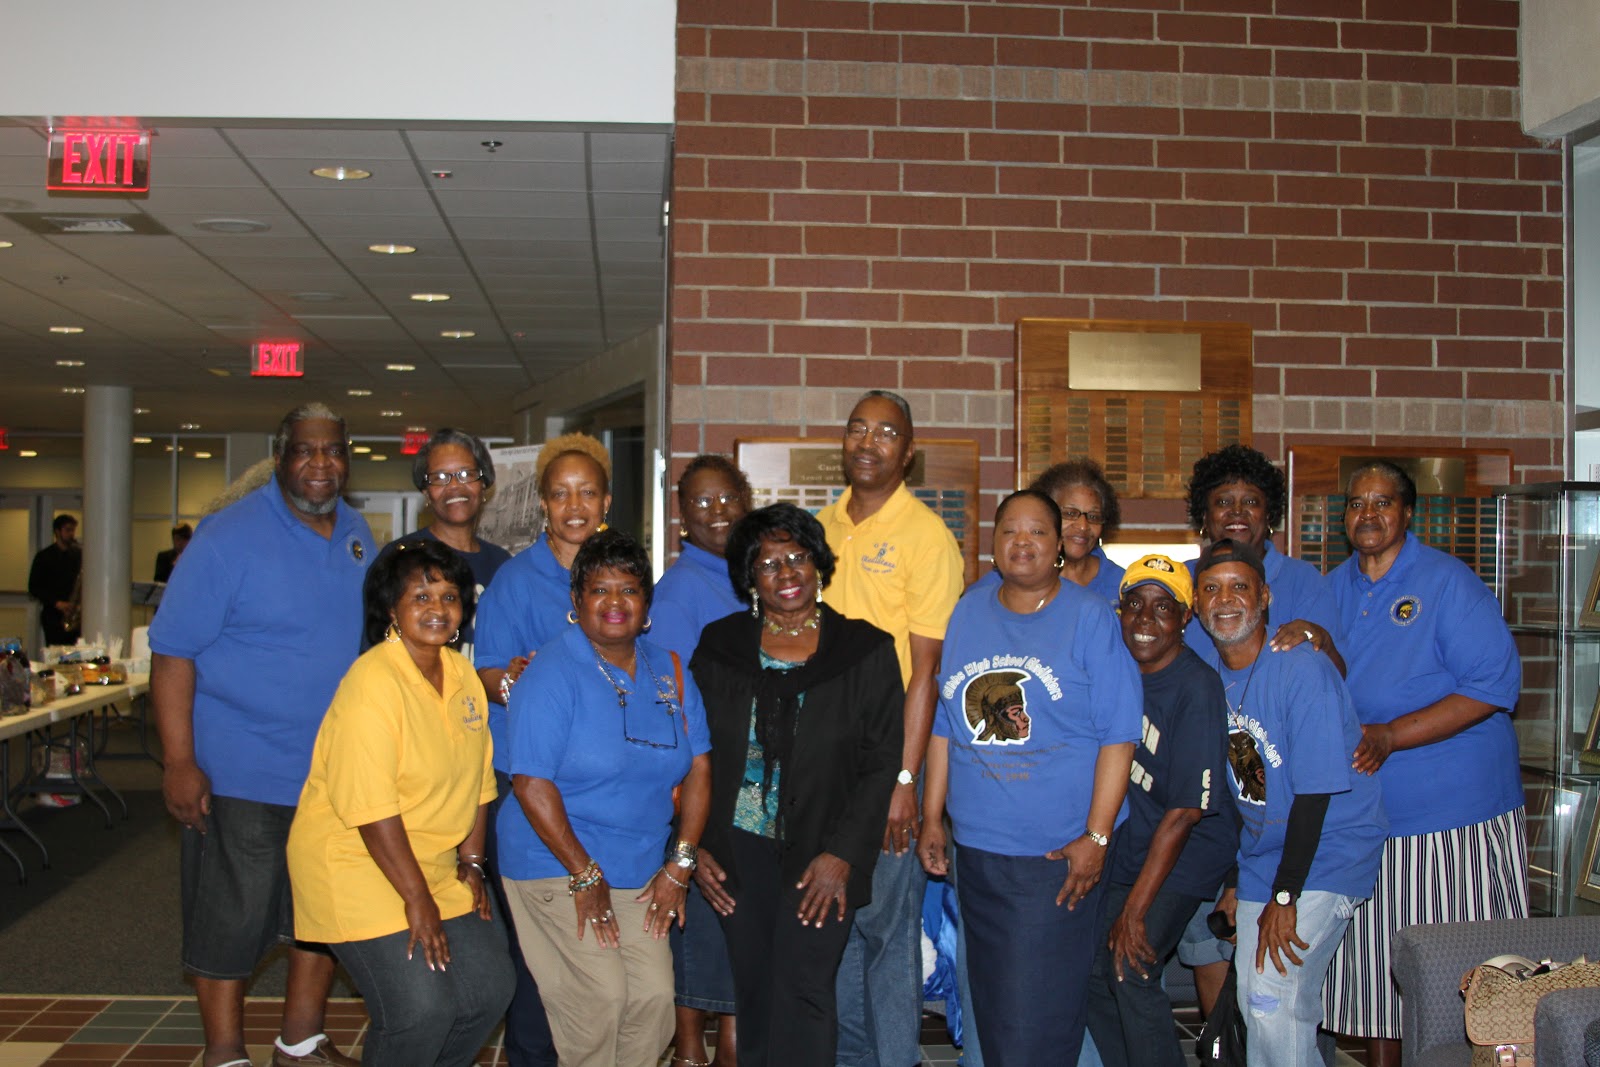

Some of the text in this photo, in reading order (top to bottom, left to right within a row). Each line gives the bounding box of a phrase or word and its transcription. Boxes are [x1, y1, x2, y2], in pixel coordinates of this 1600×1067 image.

[62, 132, 140, 185] EXIT
[258, 342, 300, 371] EXIT
[963, 658, 991, 677] High
[992, 653, 1029, 669] School
[1024, 657, 1063, 701] Gladiators
